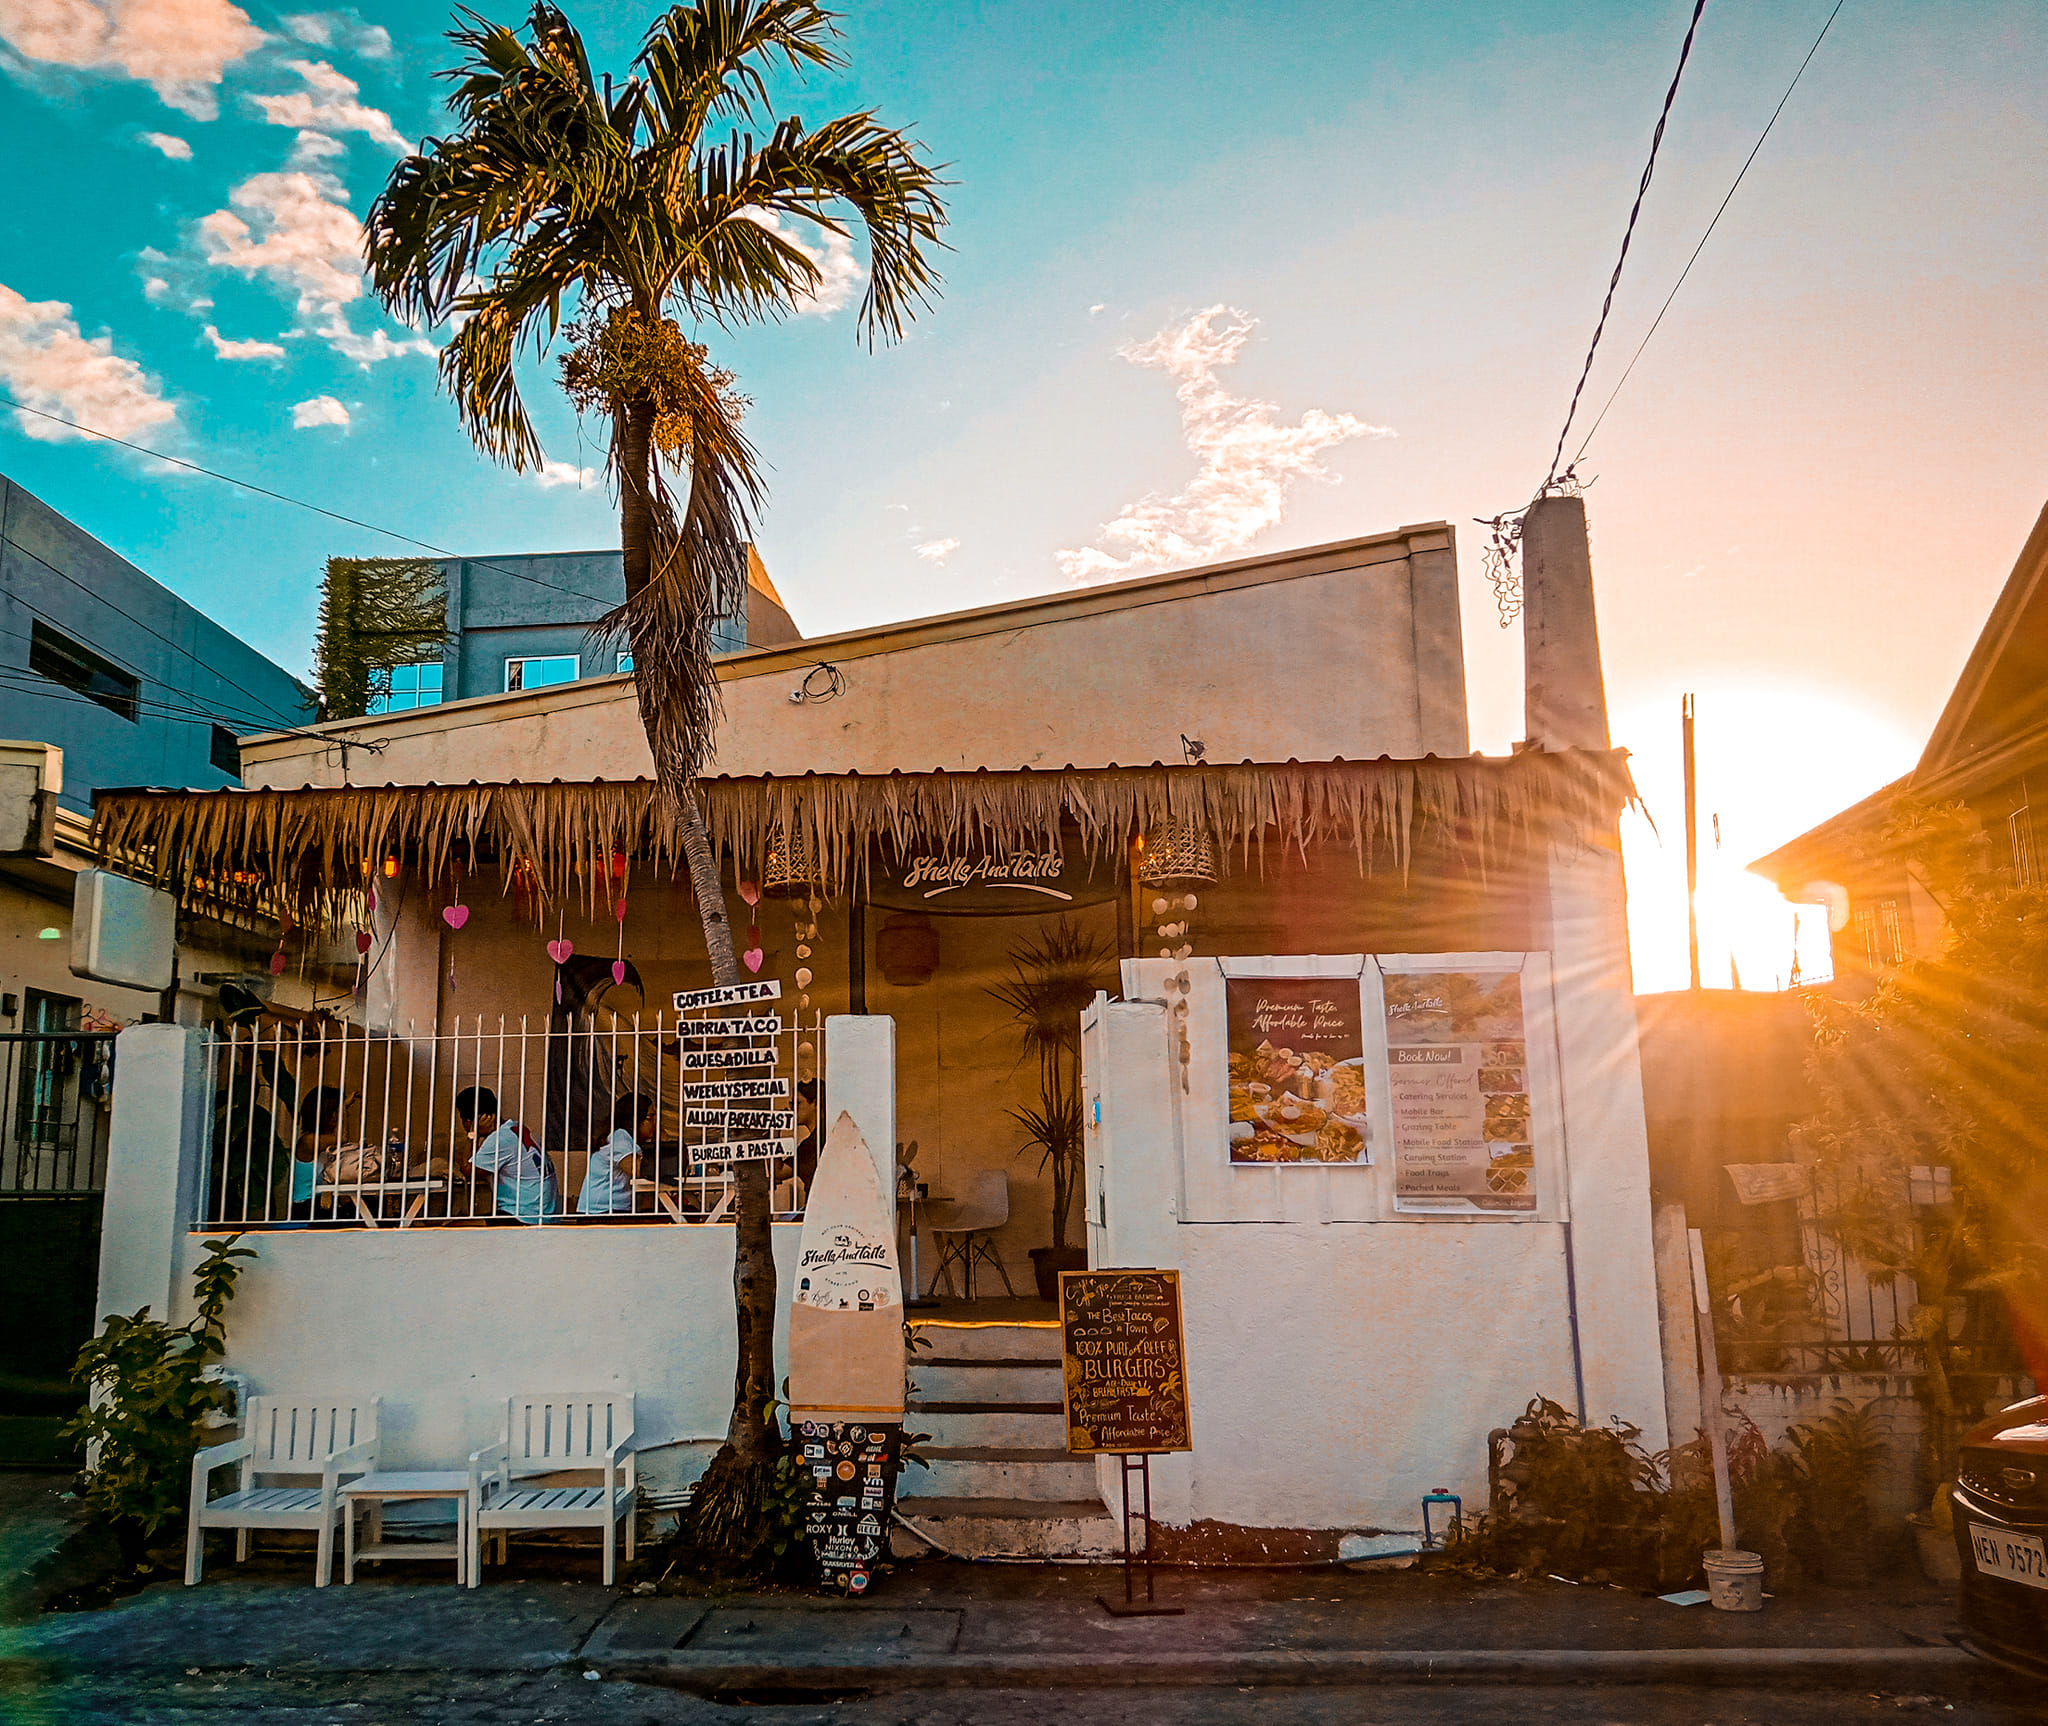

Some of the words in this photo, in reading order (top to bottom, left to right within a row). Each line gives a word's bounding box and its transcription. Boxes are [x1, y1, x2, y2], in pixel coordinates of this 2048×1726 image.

[735, 984, 773, 1000] TEA
[1256, 998, 1305, 1013] Premium
[1252, 1014, 1307, 1032] Affordable
[1313, 1015, 1344, 1029] Price
[685, 1050, 775, 1068] QUESADILLA
[1399, 1050, 1424, 1062] Book
[1425, 1050, 1451, 1062] Now!
[1399, 1092, 1434, 1102] Catering
[1435, 1092, 1468, 1100] Services
[1401, 1107, 1428, 1115] Mobile
[728, 1111, 794, 1129] BREAKFAST
[1402, 1123, 1432, 1133] Grazing
[692, 1146, 732, 1162] BURGER
[736, 1145, 745, 1158] &
[1404, 1154, 1435, 1163] Carving
[1427, 1169, 1450, 1178] Trays
[1124, 1308, 1153, 1322] Tacos
[1124, 1322, 1148, 1336] Town
[1075, 1340, 1102, 1356] 100%
[1084, 1358, 1166, 1380] BURGERS
[1080, 1408, 1121, 1425] Premium
[806, 1524, 833, 1534] ROXY
[829, 1535, 856, 1545] Hurley
[825, 1544, 852, 1552] NIXON
[1973, 1535, 2001, 1566] NEN
[2006, 1544, 2045, 1577] 9572
